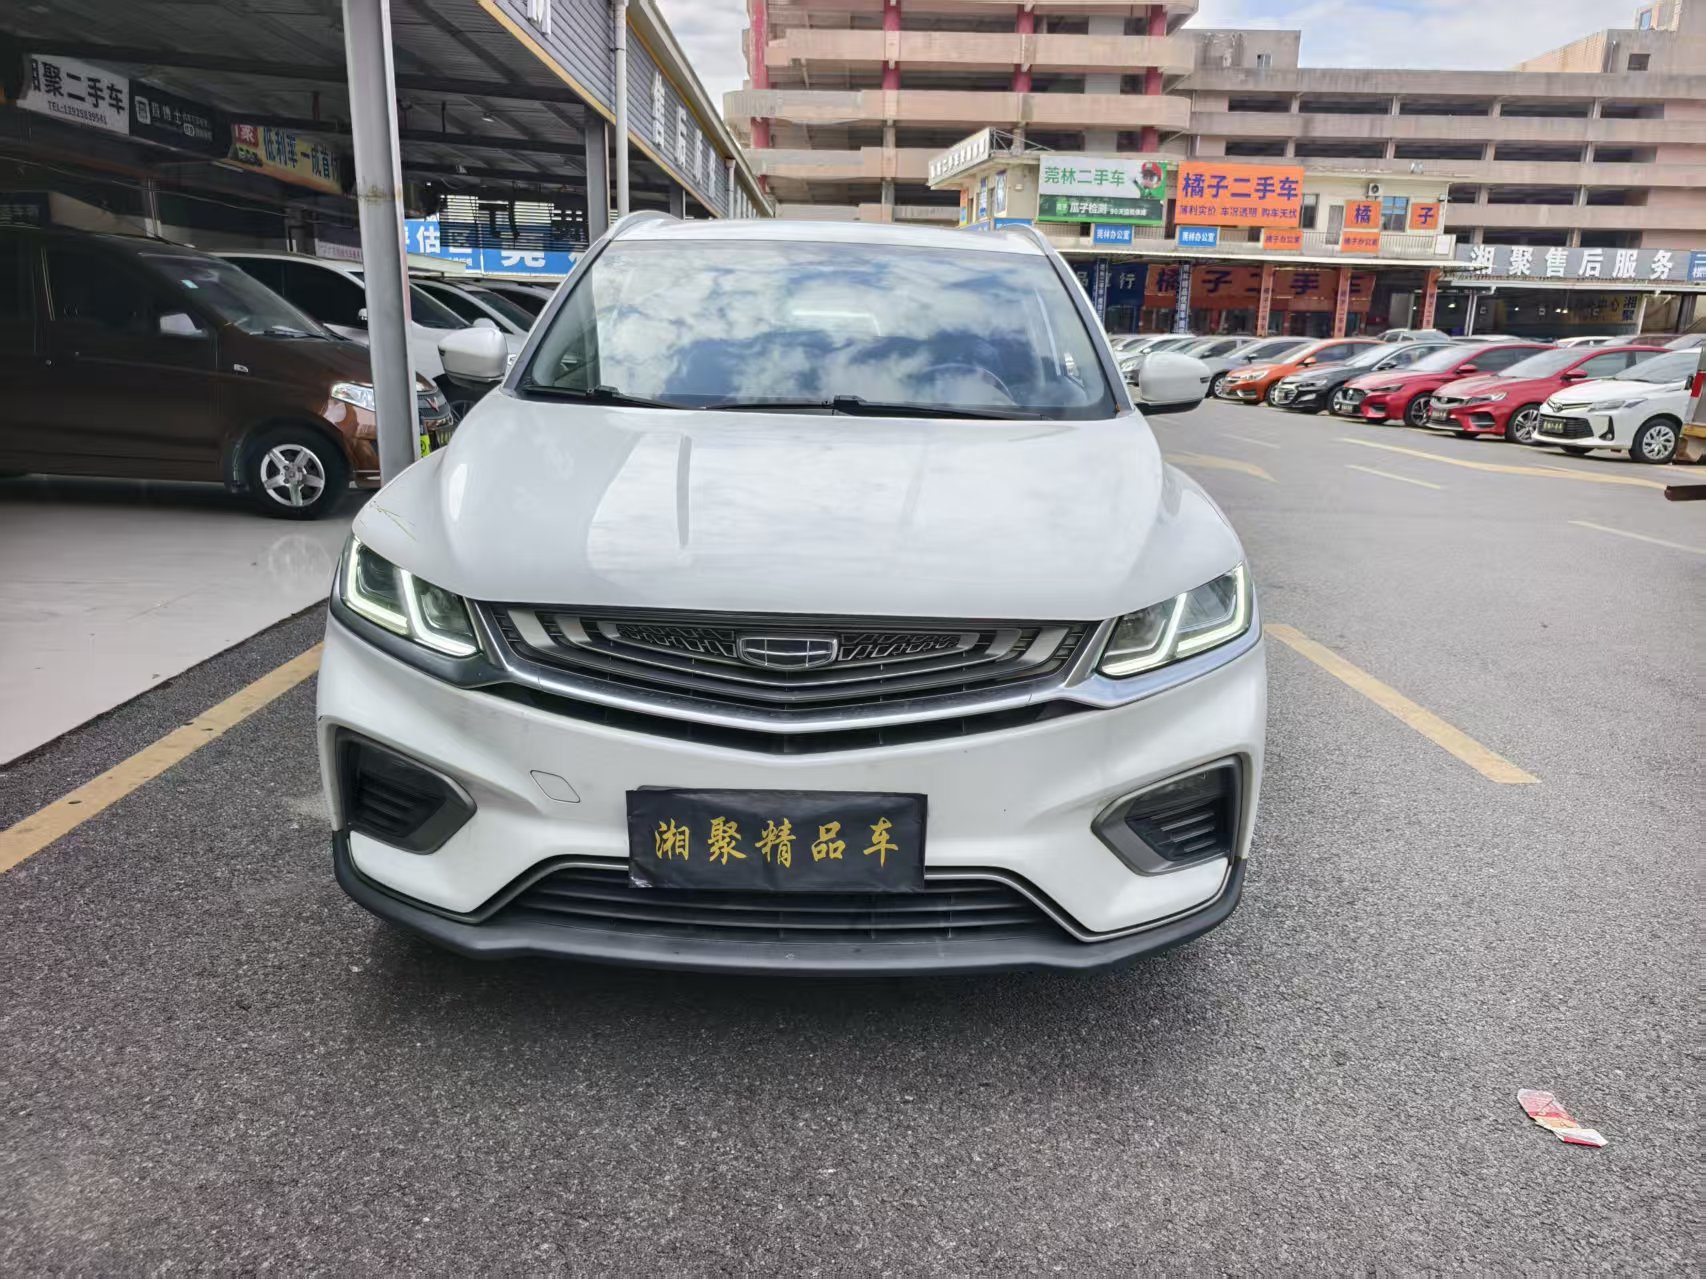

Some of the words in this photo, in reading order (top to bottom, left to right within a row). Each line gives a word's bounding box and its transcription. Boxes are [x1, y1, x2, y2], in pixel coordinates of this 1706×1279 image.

[1044, 165, 1125, 187] 莞林二手车
[1182, 172, 1299, 200] 橘子二手车
[1355, 204, 1372, 225] 橘
[1418, 207, 1434, 225] 子
[1096, 228, 1131, 240] 莞林办公室
[1470, 245, 1673, 280] 湘聚售后服务
[655, 816, 899, 869] 湘聚精品车
